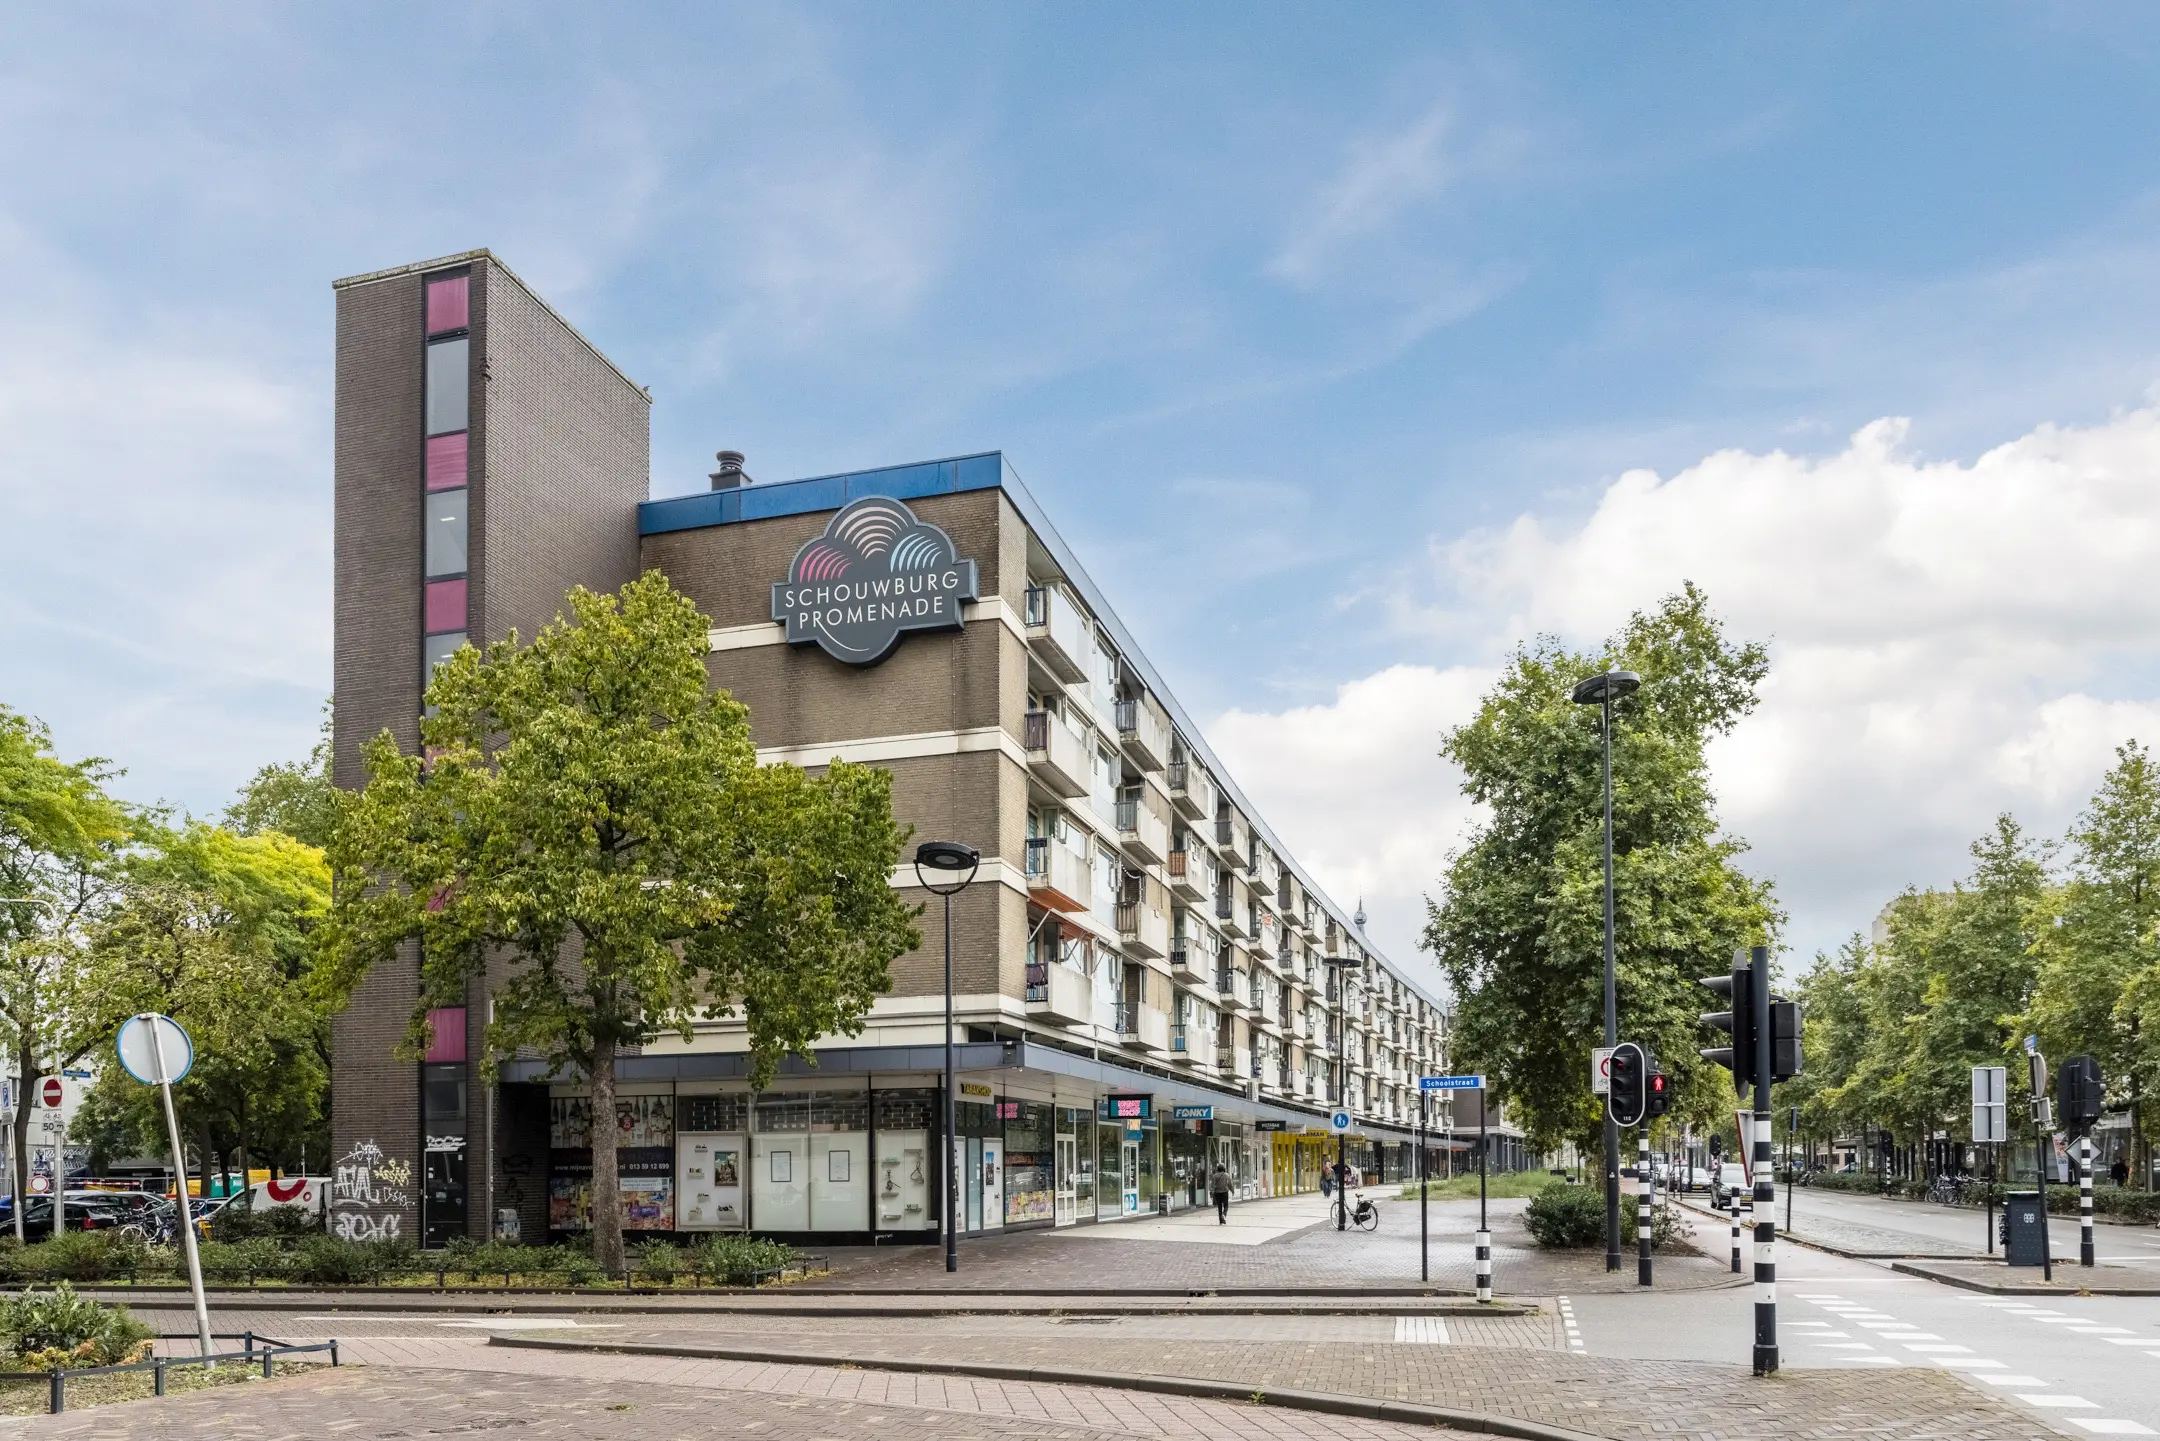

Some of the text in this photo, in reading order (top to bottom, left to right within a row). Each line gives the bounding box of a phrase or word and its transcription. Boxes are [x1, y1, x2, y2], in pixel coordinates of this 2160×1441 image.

[785, 571, 959, 608] SCHOUWBURG
[799, 596, 943, 630] PROMENADE
[1426, 1079, 1474, 1087] Schoolstraat
[1176, 1108, 1209, 1118] FONKY
[43, 1123, 54, 1131] 50
